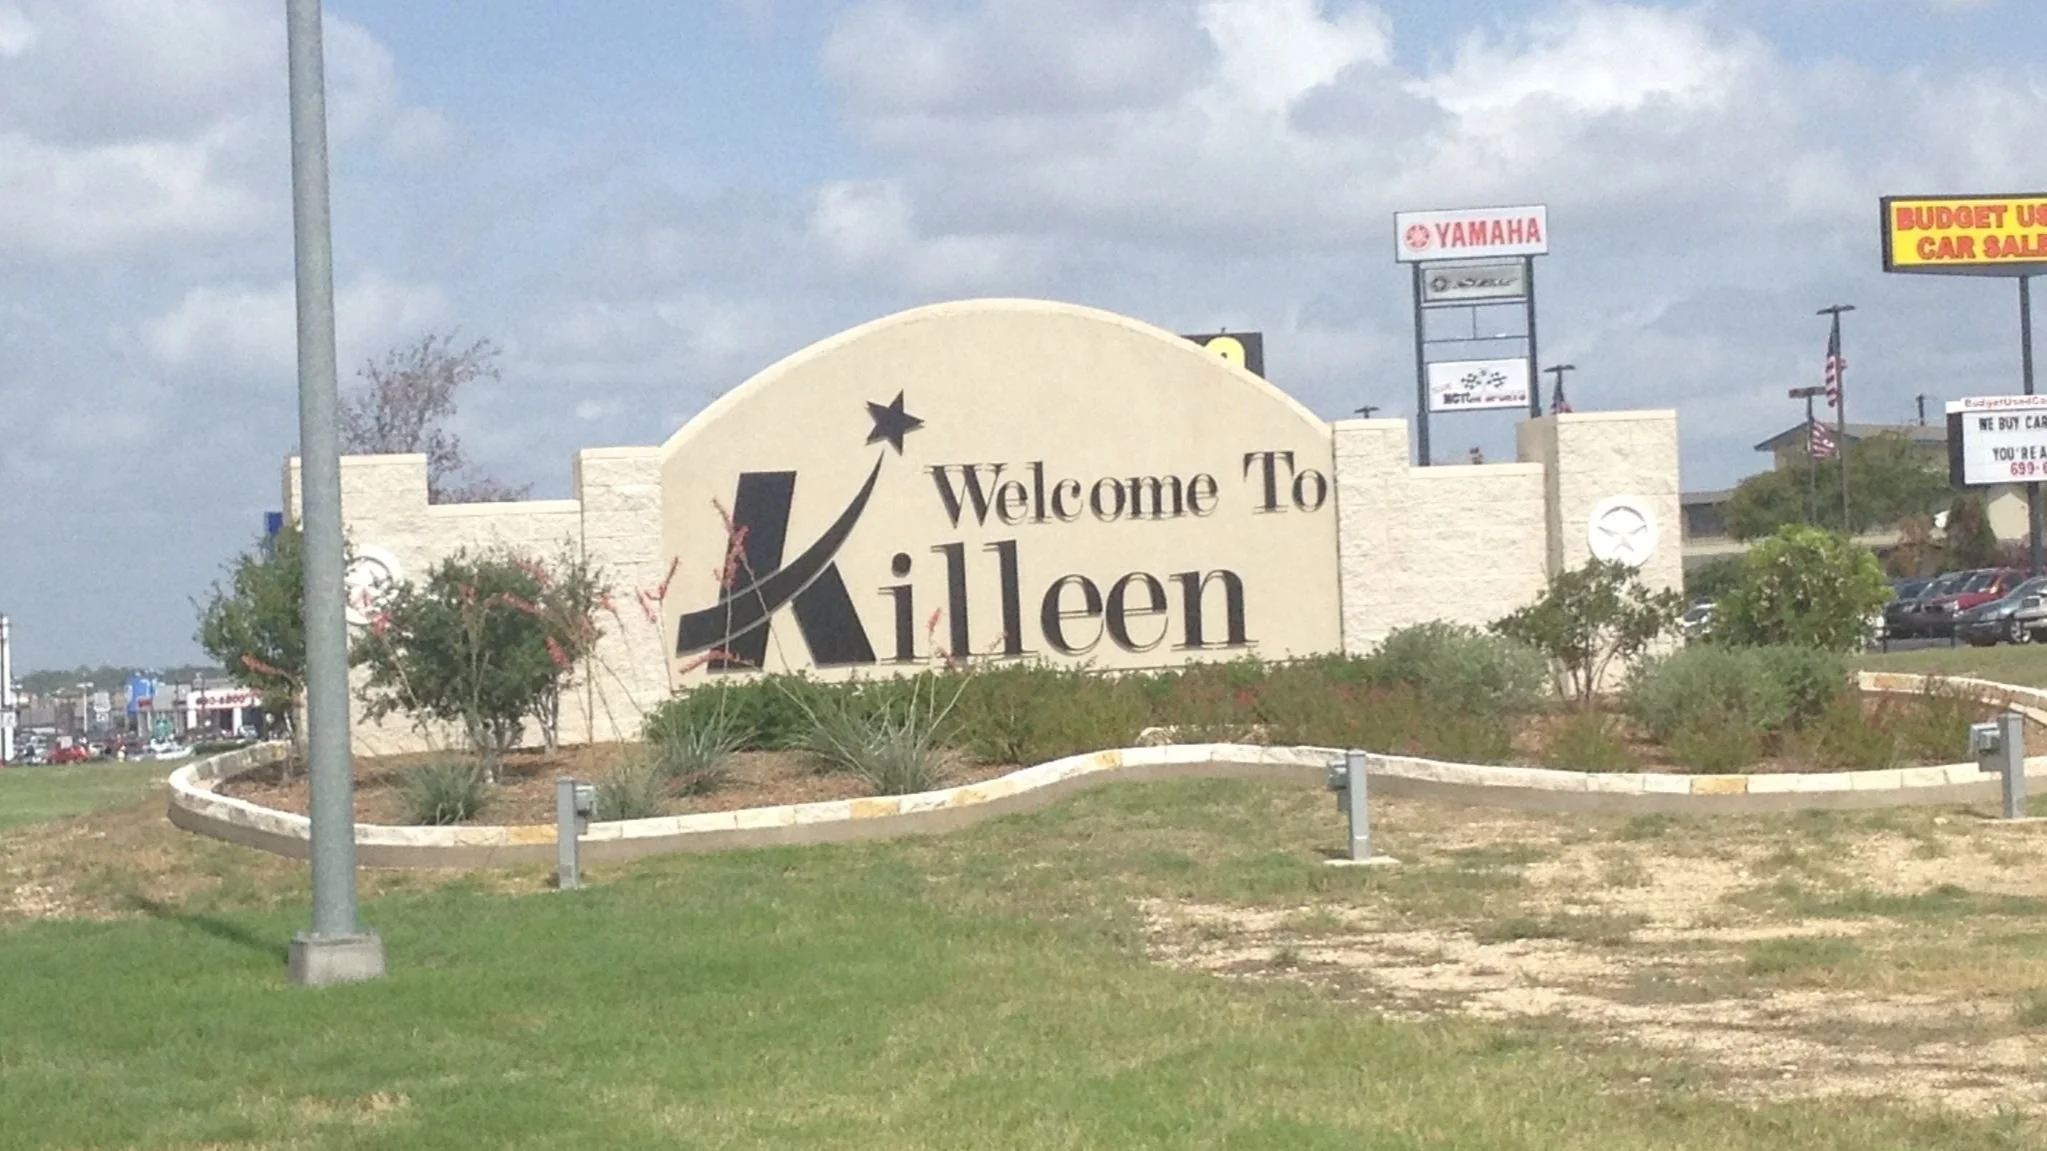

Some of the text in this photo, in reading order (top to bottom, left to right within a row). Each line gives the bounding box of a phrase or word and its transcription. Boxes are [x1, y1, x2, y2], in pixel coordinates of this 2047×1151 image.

[1895, 205, 2008, 230] BUDGET
[1435, 217, 1542, 248] YAMAHA
[1916, 236, 1976, 260] CAR
[1978, 416, 1994, 431] WE
[1998, 416, 2020, 431] BUY
[1992, 446, 2036, 461] YOU'RE
[924, 450, 1329, 528] Welcome To
[676, 450, 1260, 674] Killeen
